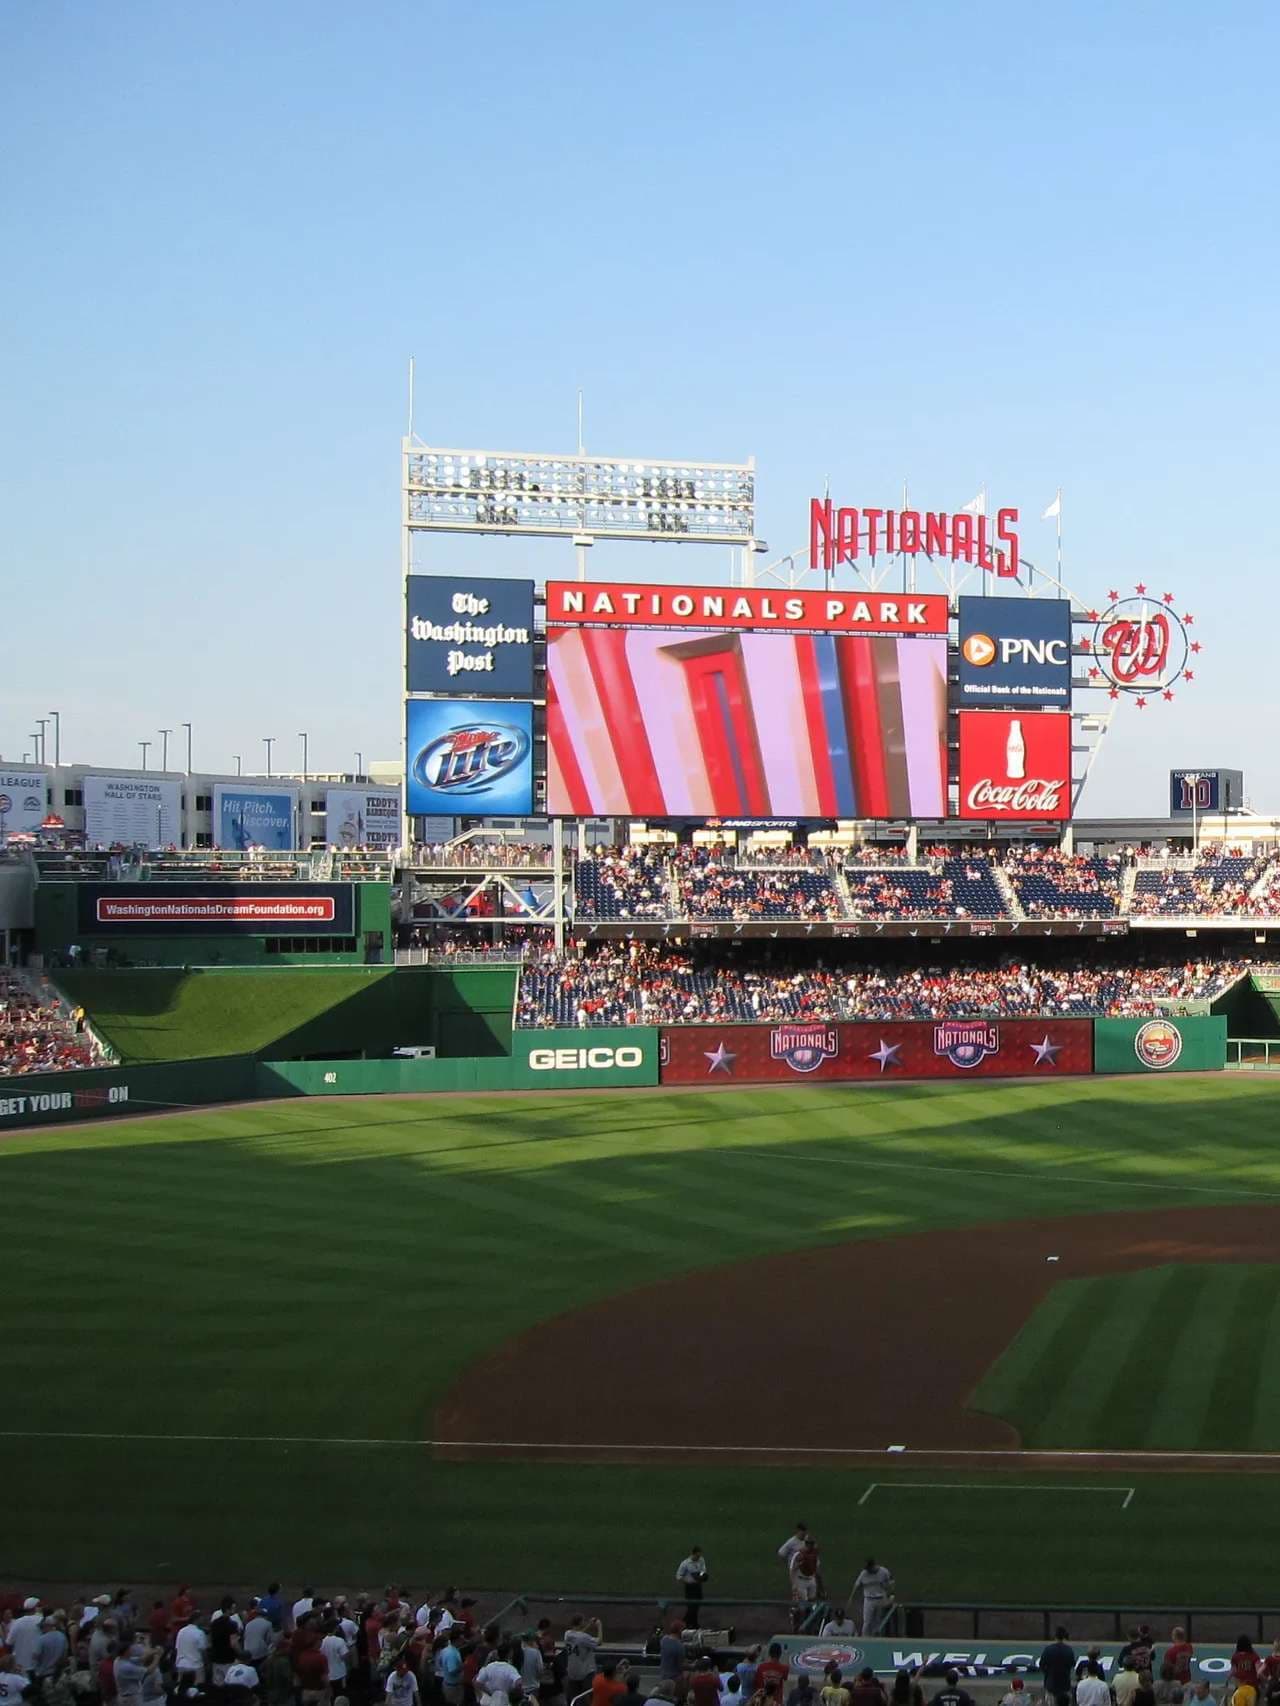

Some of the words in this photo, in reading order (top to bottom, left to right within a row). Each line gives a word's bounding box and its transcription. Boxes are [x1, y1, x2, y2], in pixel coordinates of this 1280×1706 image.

[810, 498, 1019, 577] NATIONALS
[452, 592, 489, 616] The
[563, 590, 805, 620] NATIONALS
[826, 600, 928, 625] PARK
[411, 616, 530, 647] Washington
[447, 650, 494, 675] Post
[999, 638, 1068, 665] PNC
[963, 683, 990, 694] Official
[991, 685, 1011, 695] Bank
[1011, 685, 1020, 695] of
[1020, 686, 1032, 695] the
[1032, 686, 1067, 696] Nationals
[432, 740, 514, 787] Lite
[1, 777, 41, 788] LEAGUE
[107, 783, 161, 792] WASHINGTON
[104, 791, 124, 799] HALL
[138, 792, 162, 800] STARS
[366, 796, 399, 808] TEDDY'S
[106, 903, 325, 917] WashingtonNationalsDreamFoundation.org
[774, 1031, 835, 1054] NATIONALS
[937, 1028, 996, 1050] NATIONALS
[528, 1047, 643, 1070] GEICO
[324, 1071, 337, 1083] 402
[0, 1097, 26, 1116] GET
[29, 1092, 72, 1112] YOUR
[108, 1086, 129, 1103] ON
